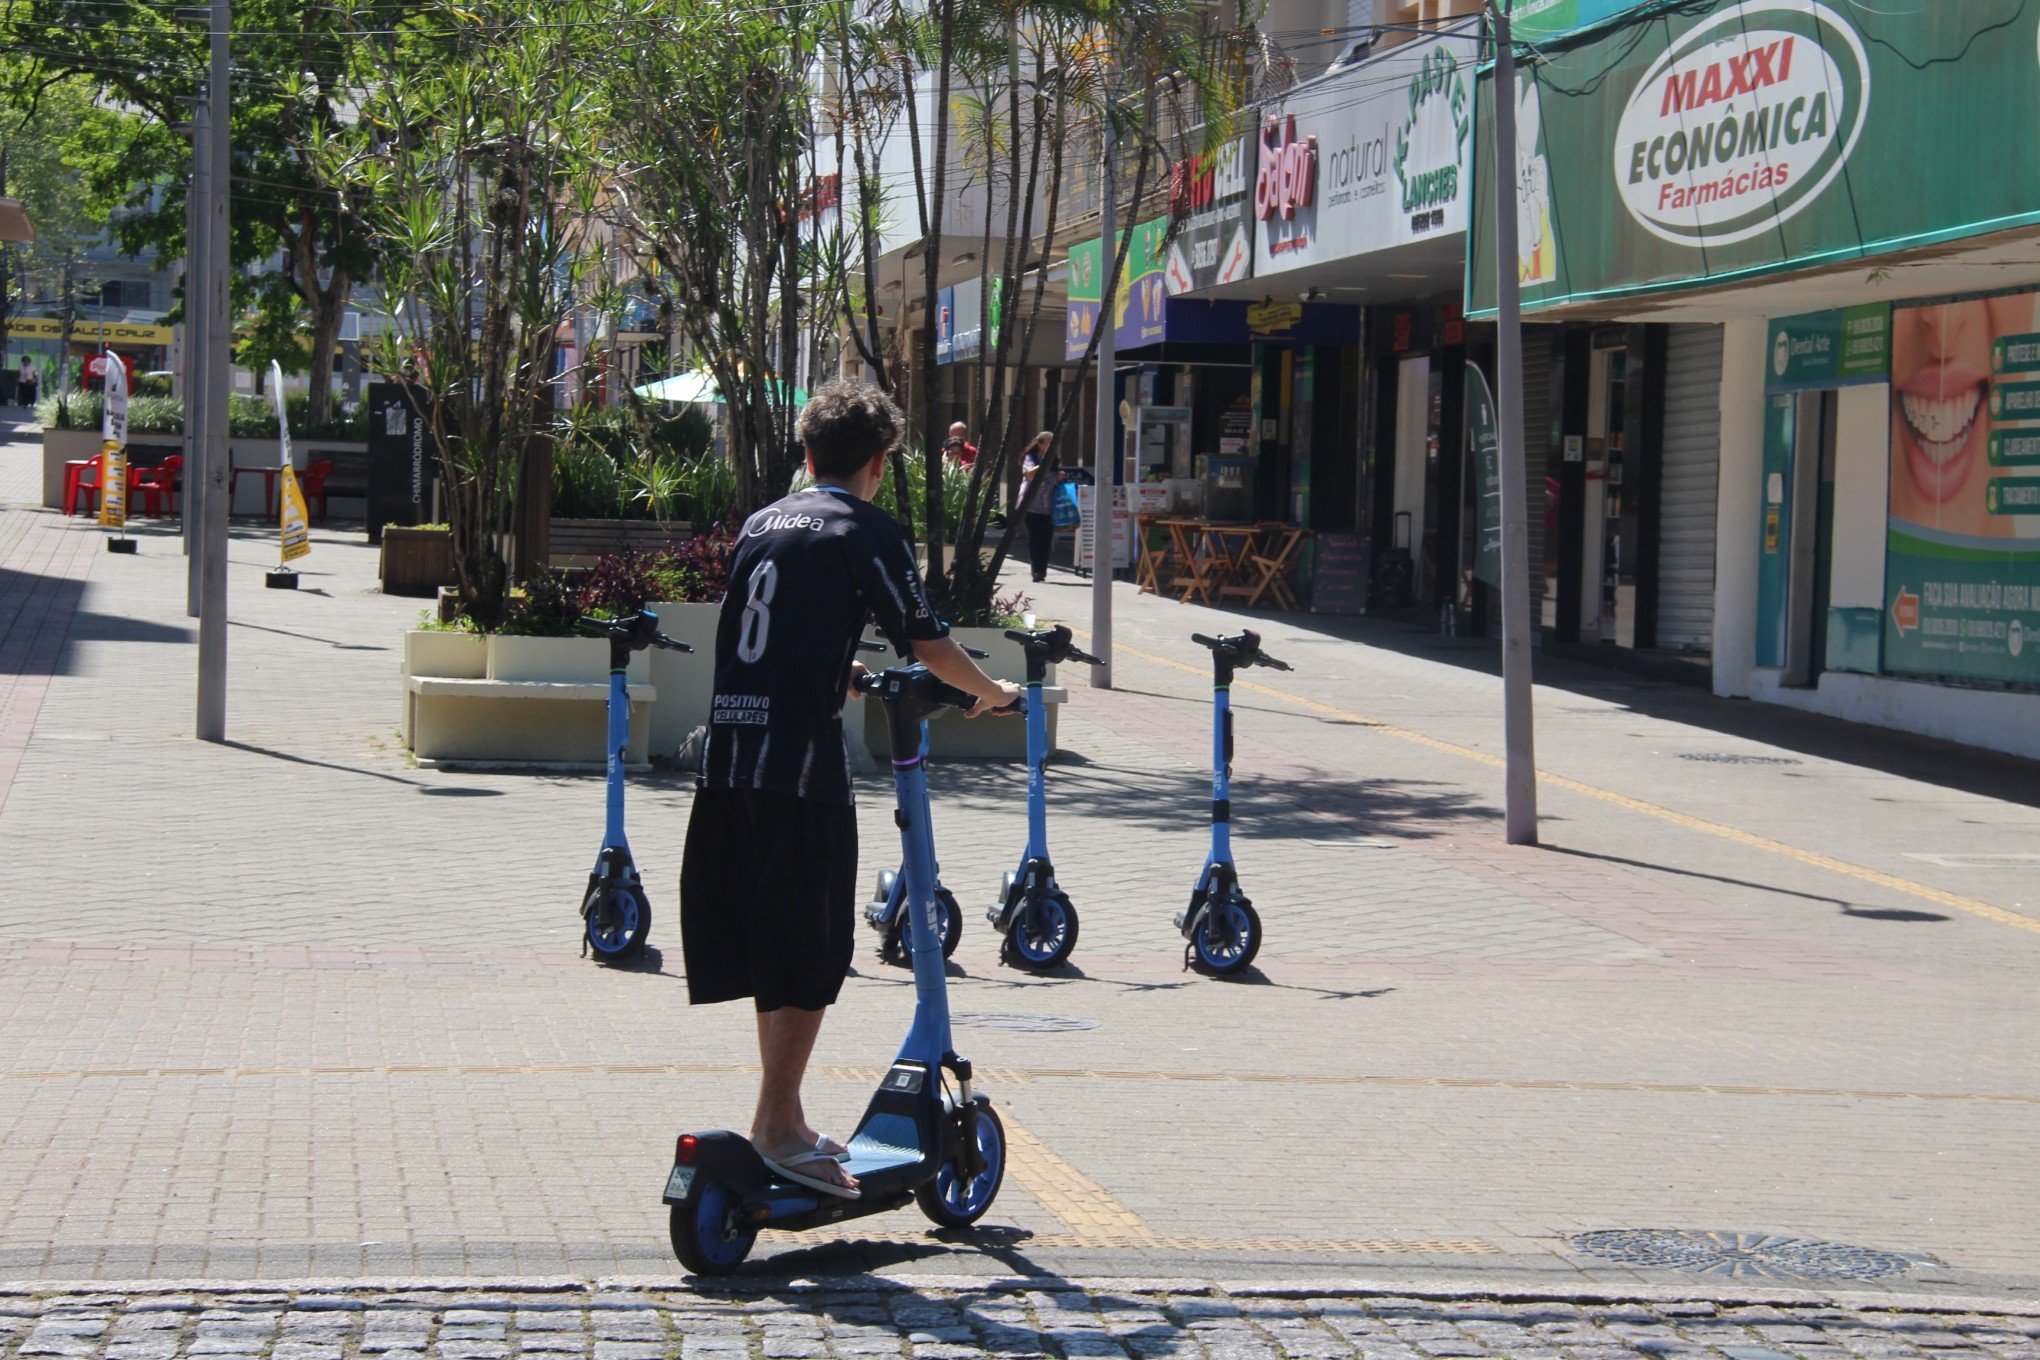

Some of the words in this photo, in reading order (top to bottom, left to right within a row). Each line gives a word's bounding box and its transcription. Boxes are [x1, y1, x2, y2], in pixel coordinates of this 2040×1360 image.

[1659, 35, 1795, 118] MAXXI
[1328, 121, 1389, 190] natural
[1628, 90, 1828, 185] ECONÔMICA
[1402, 163, 1458, 214] LANCHES
[1657, 161, 1790, 211] Farmácias
[41, 324, 112, 337] OSALDO
[115, 328, 156, 338] CRUZ
[747, 507, 825, 538] Midea
[737, 558, 779, 664] 8
[714, 694, 770, 709] POSITIVO
[714, 710, 768, 724] CELULARES
